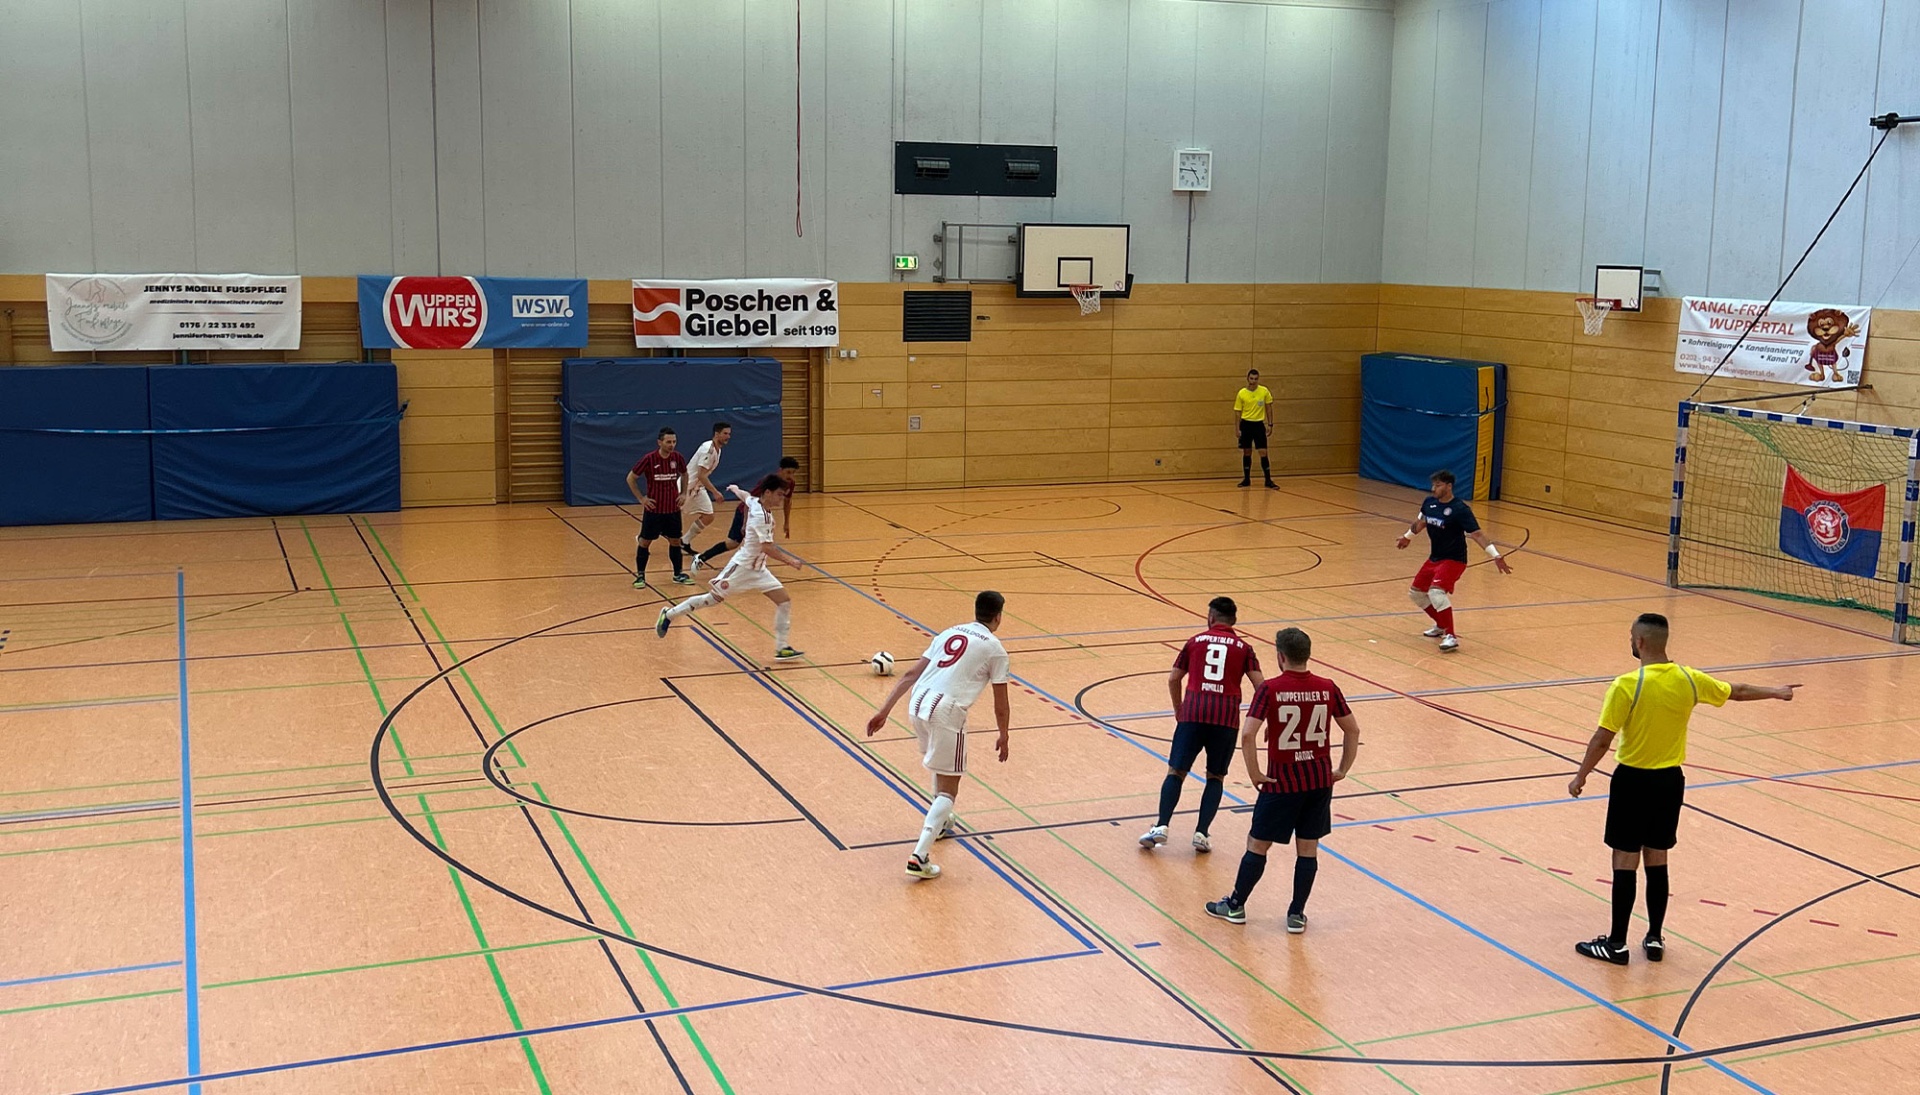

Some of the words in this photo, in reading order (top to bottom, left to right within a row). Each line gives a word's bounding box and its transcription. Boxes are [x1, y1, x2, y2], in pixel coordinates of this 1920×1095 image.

[144, 285, 183, 293] JENNYS
[185, 285, 222, 293] MOBILE
[394, 294, 477, 318] WUPPEN
[685, 288, 808, 312] Poschen
[816, 288, 837, 312] &
[396, 306, 477, 328] WIR'S
[685, 313, 777, 337] Giebel
[783, 325, 808, 336] seit
[809, 325, 837, 336] 1919
[1709, 317, 1795, 335] WUPPERTAL
[1680, 353, 1697, 361] 0202
[1744, 344, 1804, 357] Kanalsanierung
[1766, 355, 1788, 363] Kanal
[1790, 356, 1801, 364] TV
[1195, 634, 1235, 645] WUPPERTALER
[936, 634, 969, 669] 9
[1203, 643, 1229, 682] 9
[1275, 691, 1321, 702] WUPPERTALER
[1322, 690, 1331, 701] SV
[1278, 704, 1328, 750] 24
